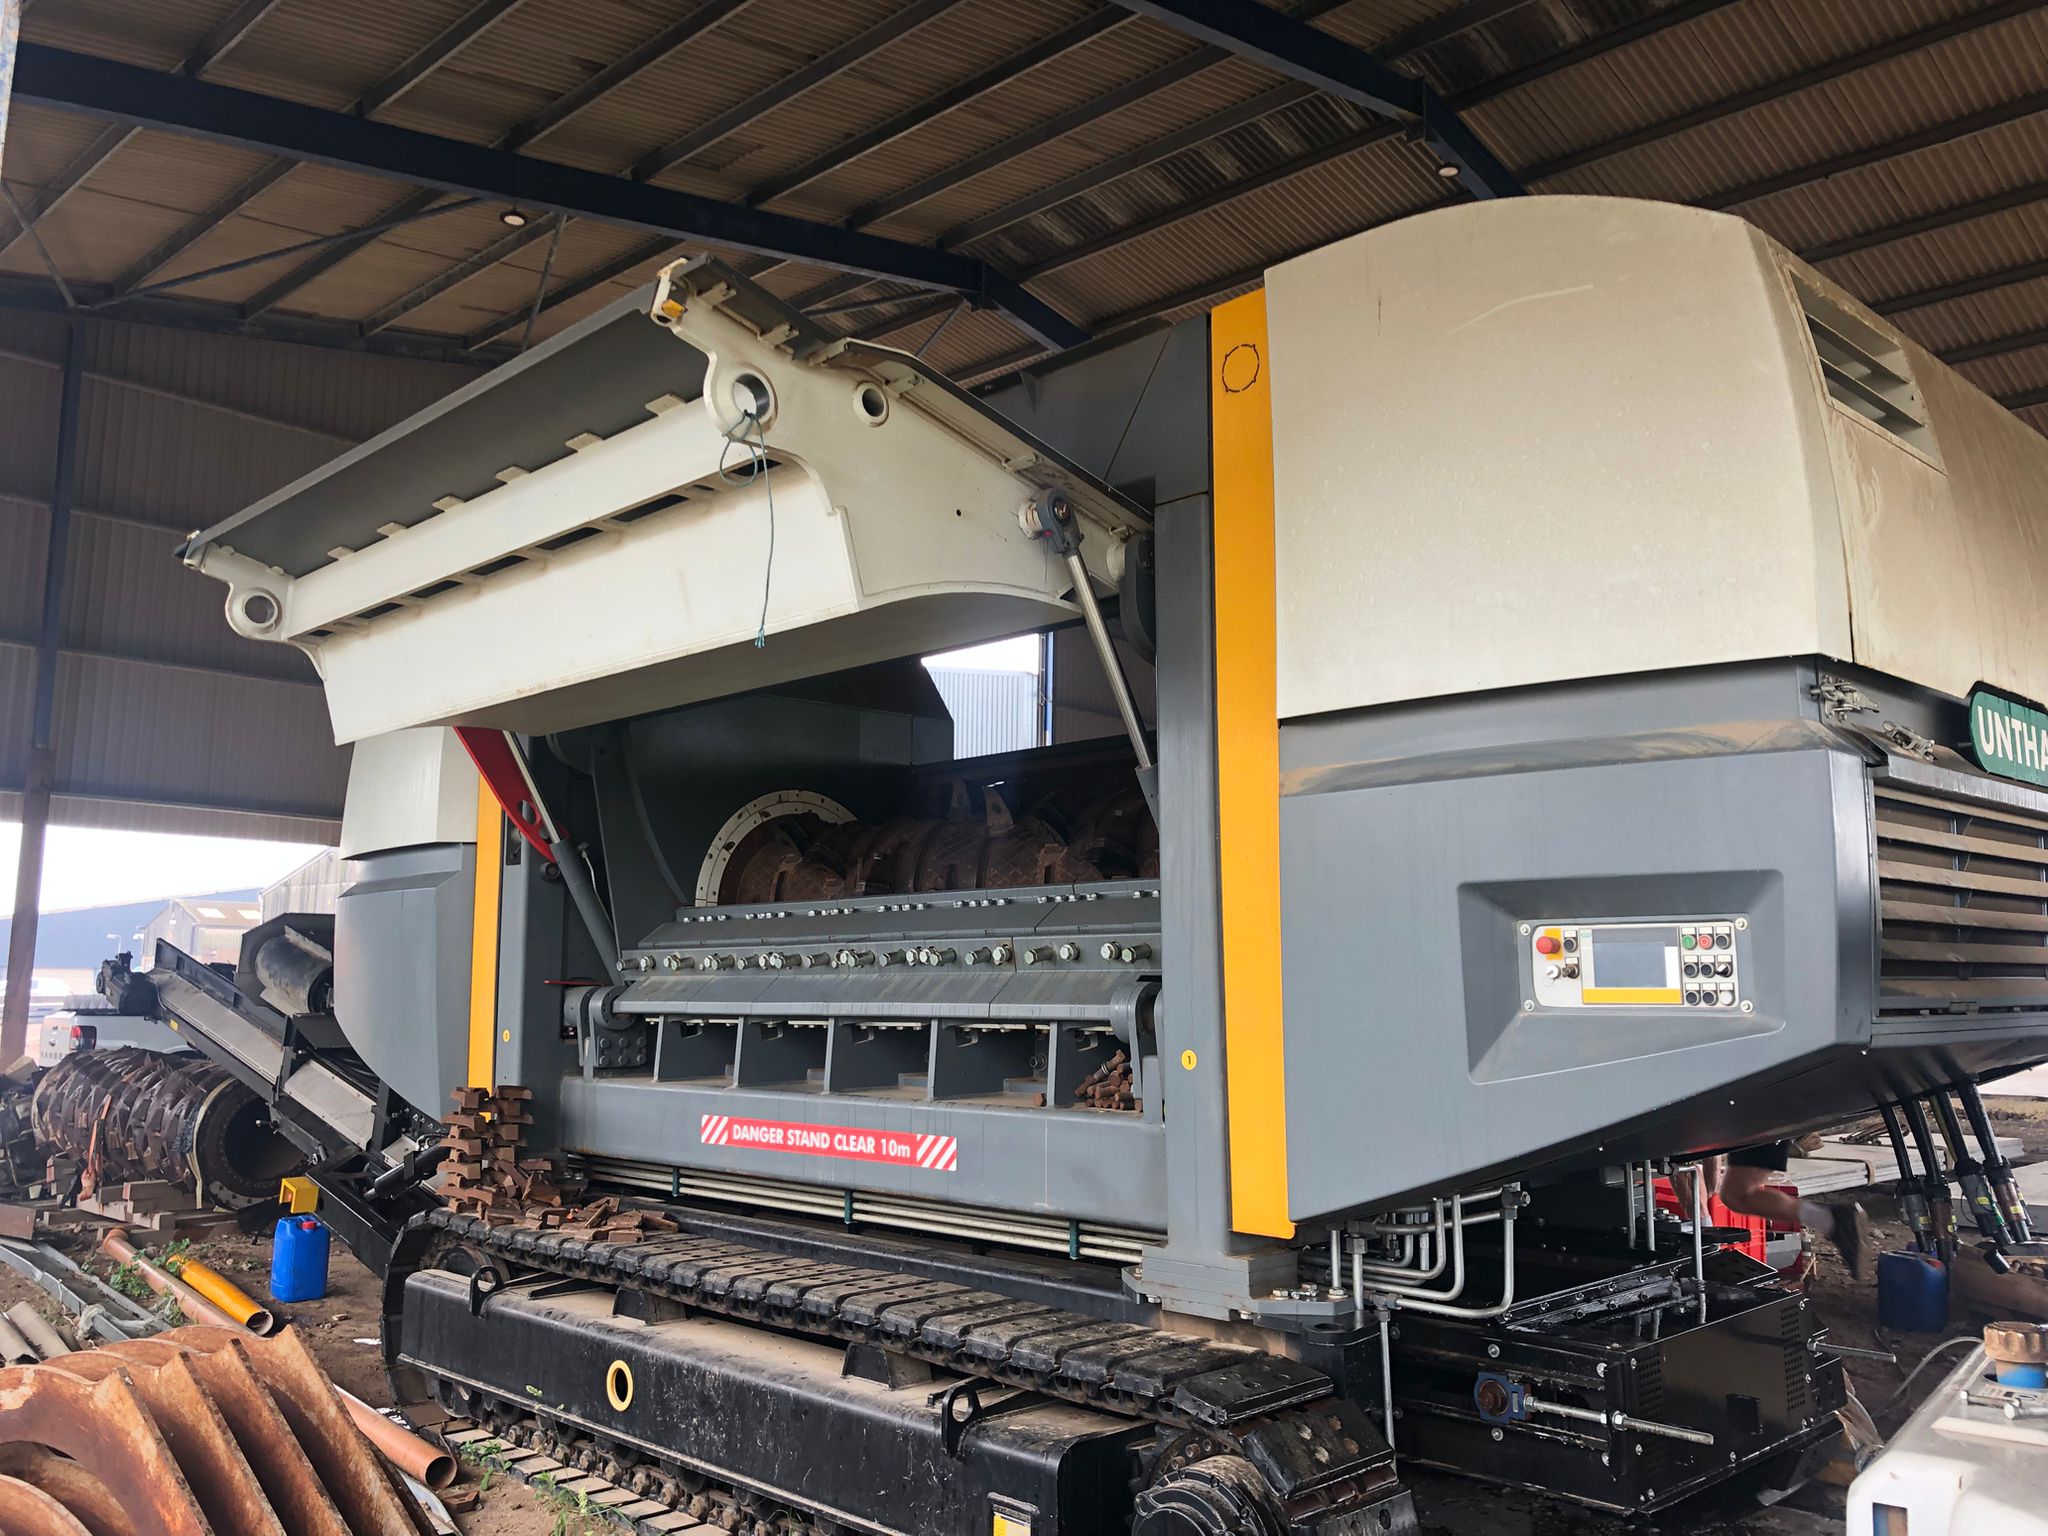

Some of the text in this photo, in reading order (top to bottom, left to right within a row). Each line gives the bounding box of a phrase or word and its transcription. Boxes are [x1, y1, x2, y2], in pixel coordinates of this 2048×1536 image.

[1978, 705, 2048, 772] UNTHA
[732, 1124, 911, 1158] DANGER STAND CLEAR 10m
